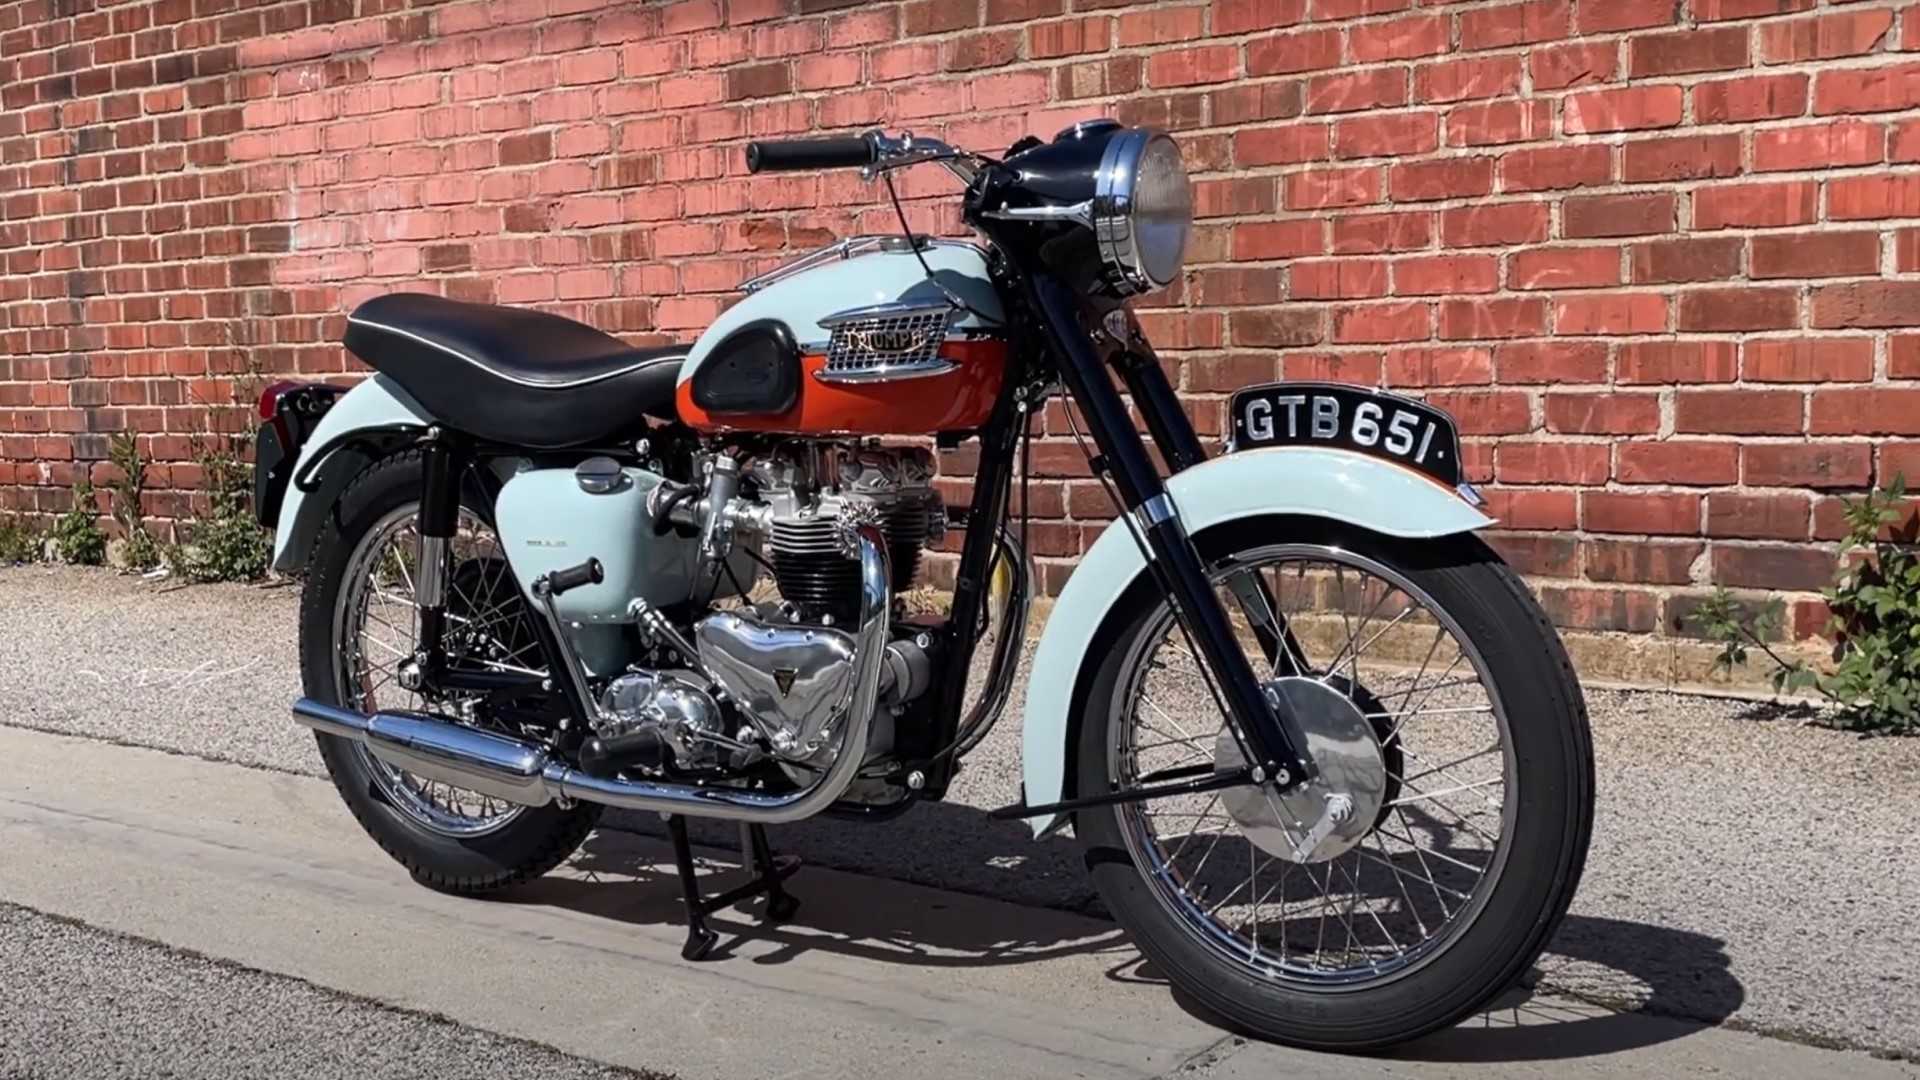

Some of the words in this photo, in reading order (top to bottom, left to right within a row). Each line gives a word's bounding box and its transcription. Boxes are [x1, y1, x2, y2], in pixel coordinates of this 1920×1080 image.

[844, 328, 926, 352] TRIUMPH
[1245, 395, 1340, 440] GTB
[1352, 402, 1436, 463] 651
